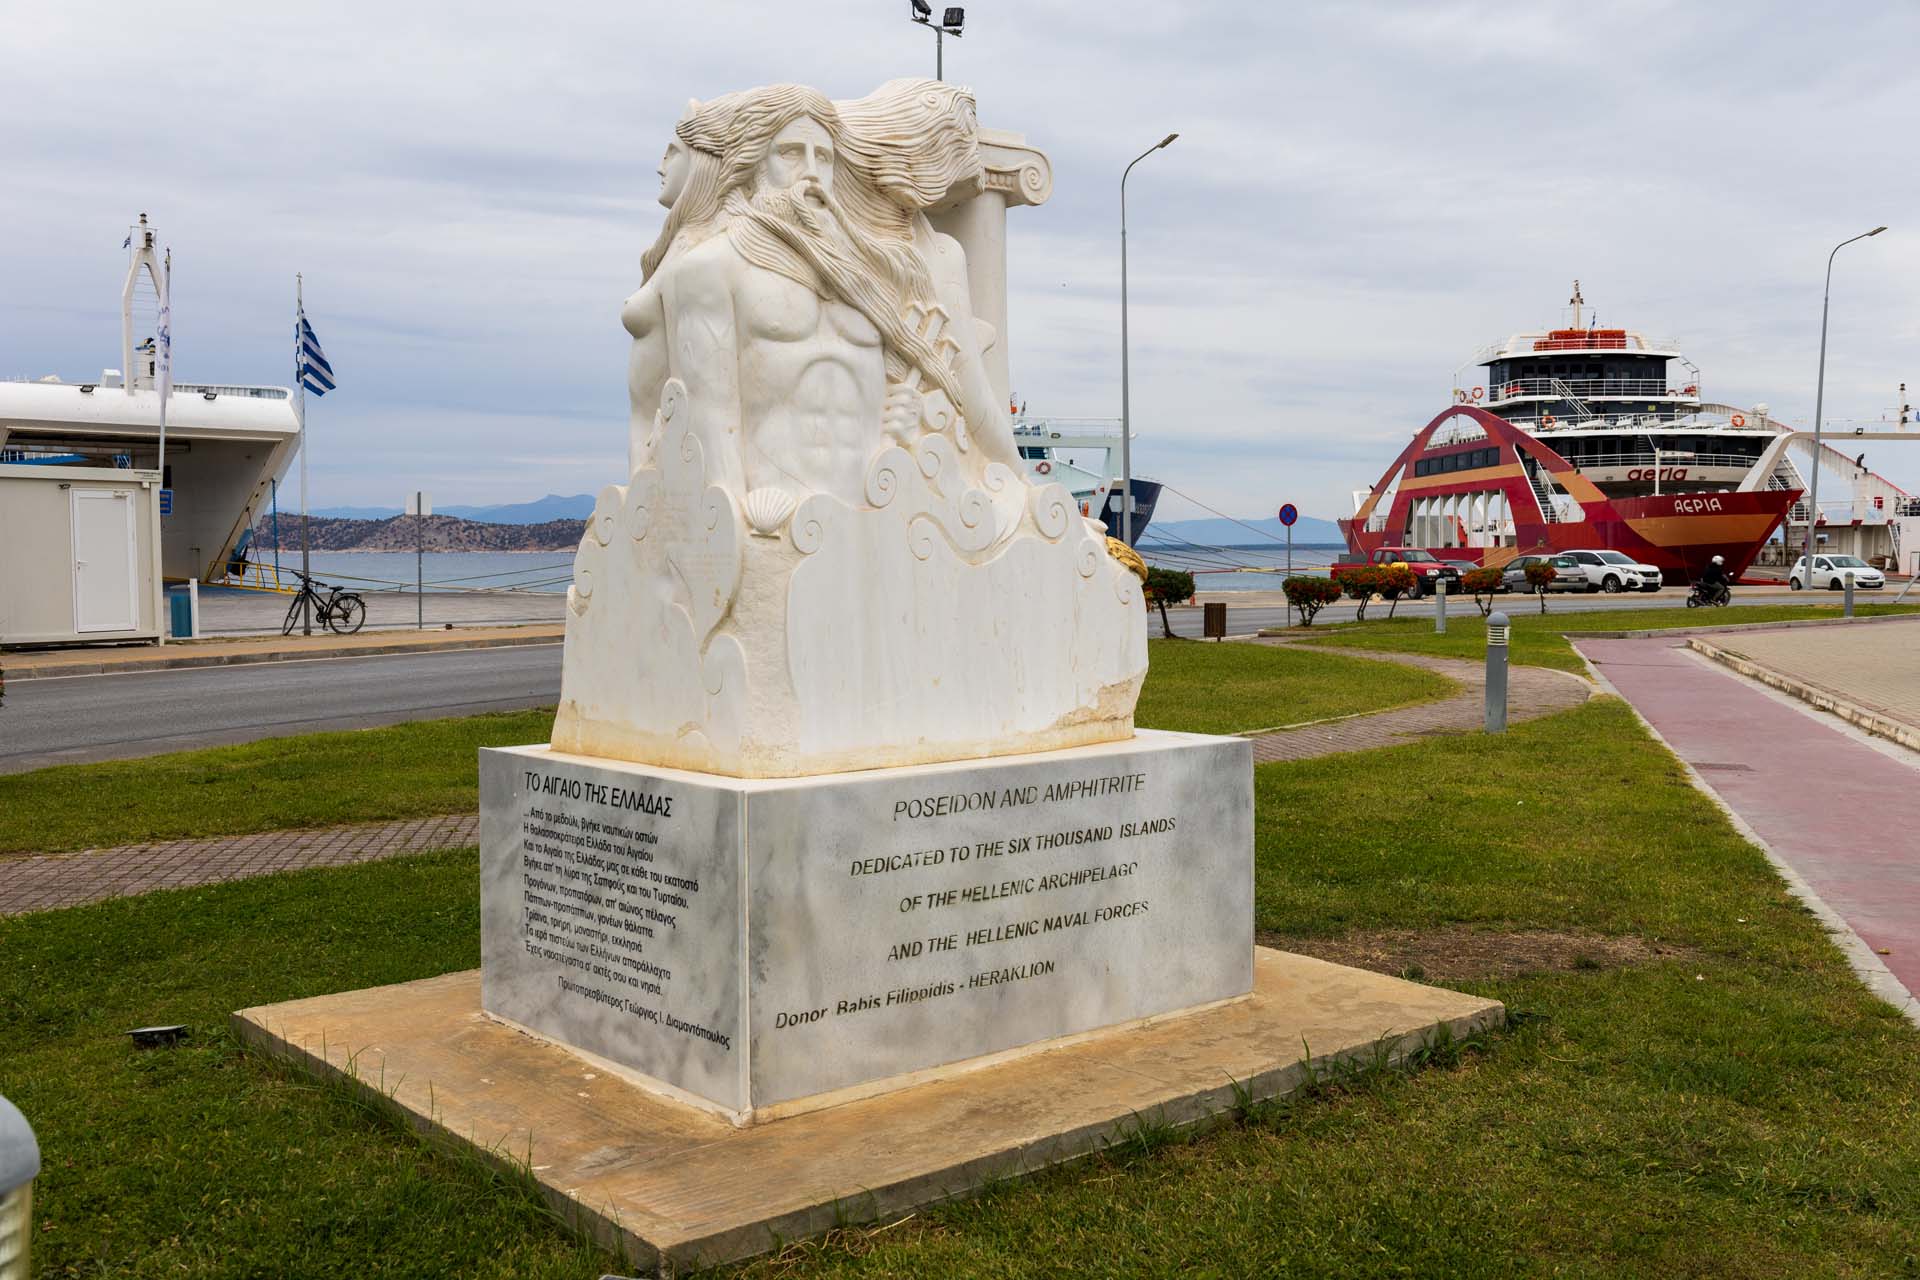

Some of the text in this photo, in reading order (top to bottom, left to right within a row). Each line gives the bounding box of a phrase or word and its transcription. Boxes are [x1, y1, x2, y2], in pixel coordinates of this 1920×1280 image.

[1628, 467, 1688, 481] aeria
[525, 772, 673, 818] ΤΟ ΑΙΓΑΙΟ ΤΗΣ ΕΛΛΑΔΑΣ
[893, 773, 1146, 821] POSEIDON AND AMPHITRITE
[851, 817, 1176, 876] DEDICATED TO THE SIX THOUSAND ISLANDS
[639, 887, 651, 899] του
[650, 872, 662, 883] του
[900, 862, 1138, 913] OF THE HELLENIC ARCHIPELAGO
[888, 900, 1149, 961] AND THE HELLENIC NAVAL FORCES
[775, 1007, 829, 1029] Donor
[837, 996, 881, 1016] Babis
[886, 981, 954, 1006] Filippidis
[969, 960, 1054, 989] HERAKLION
